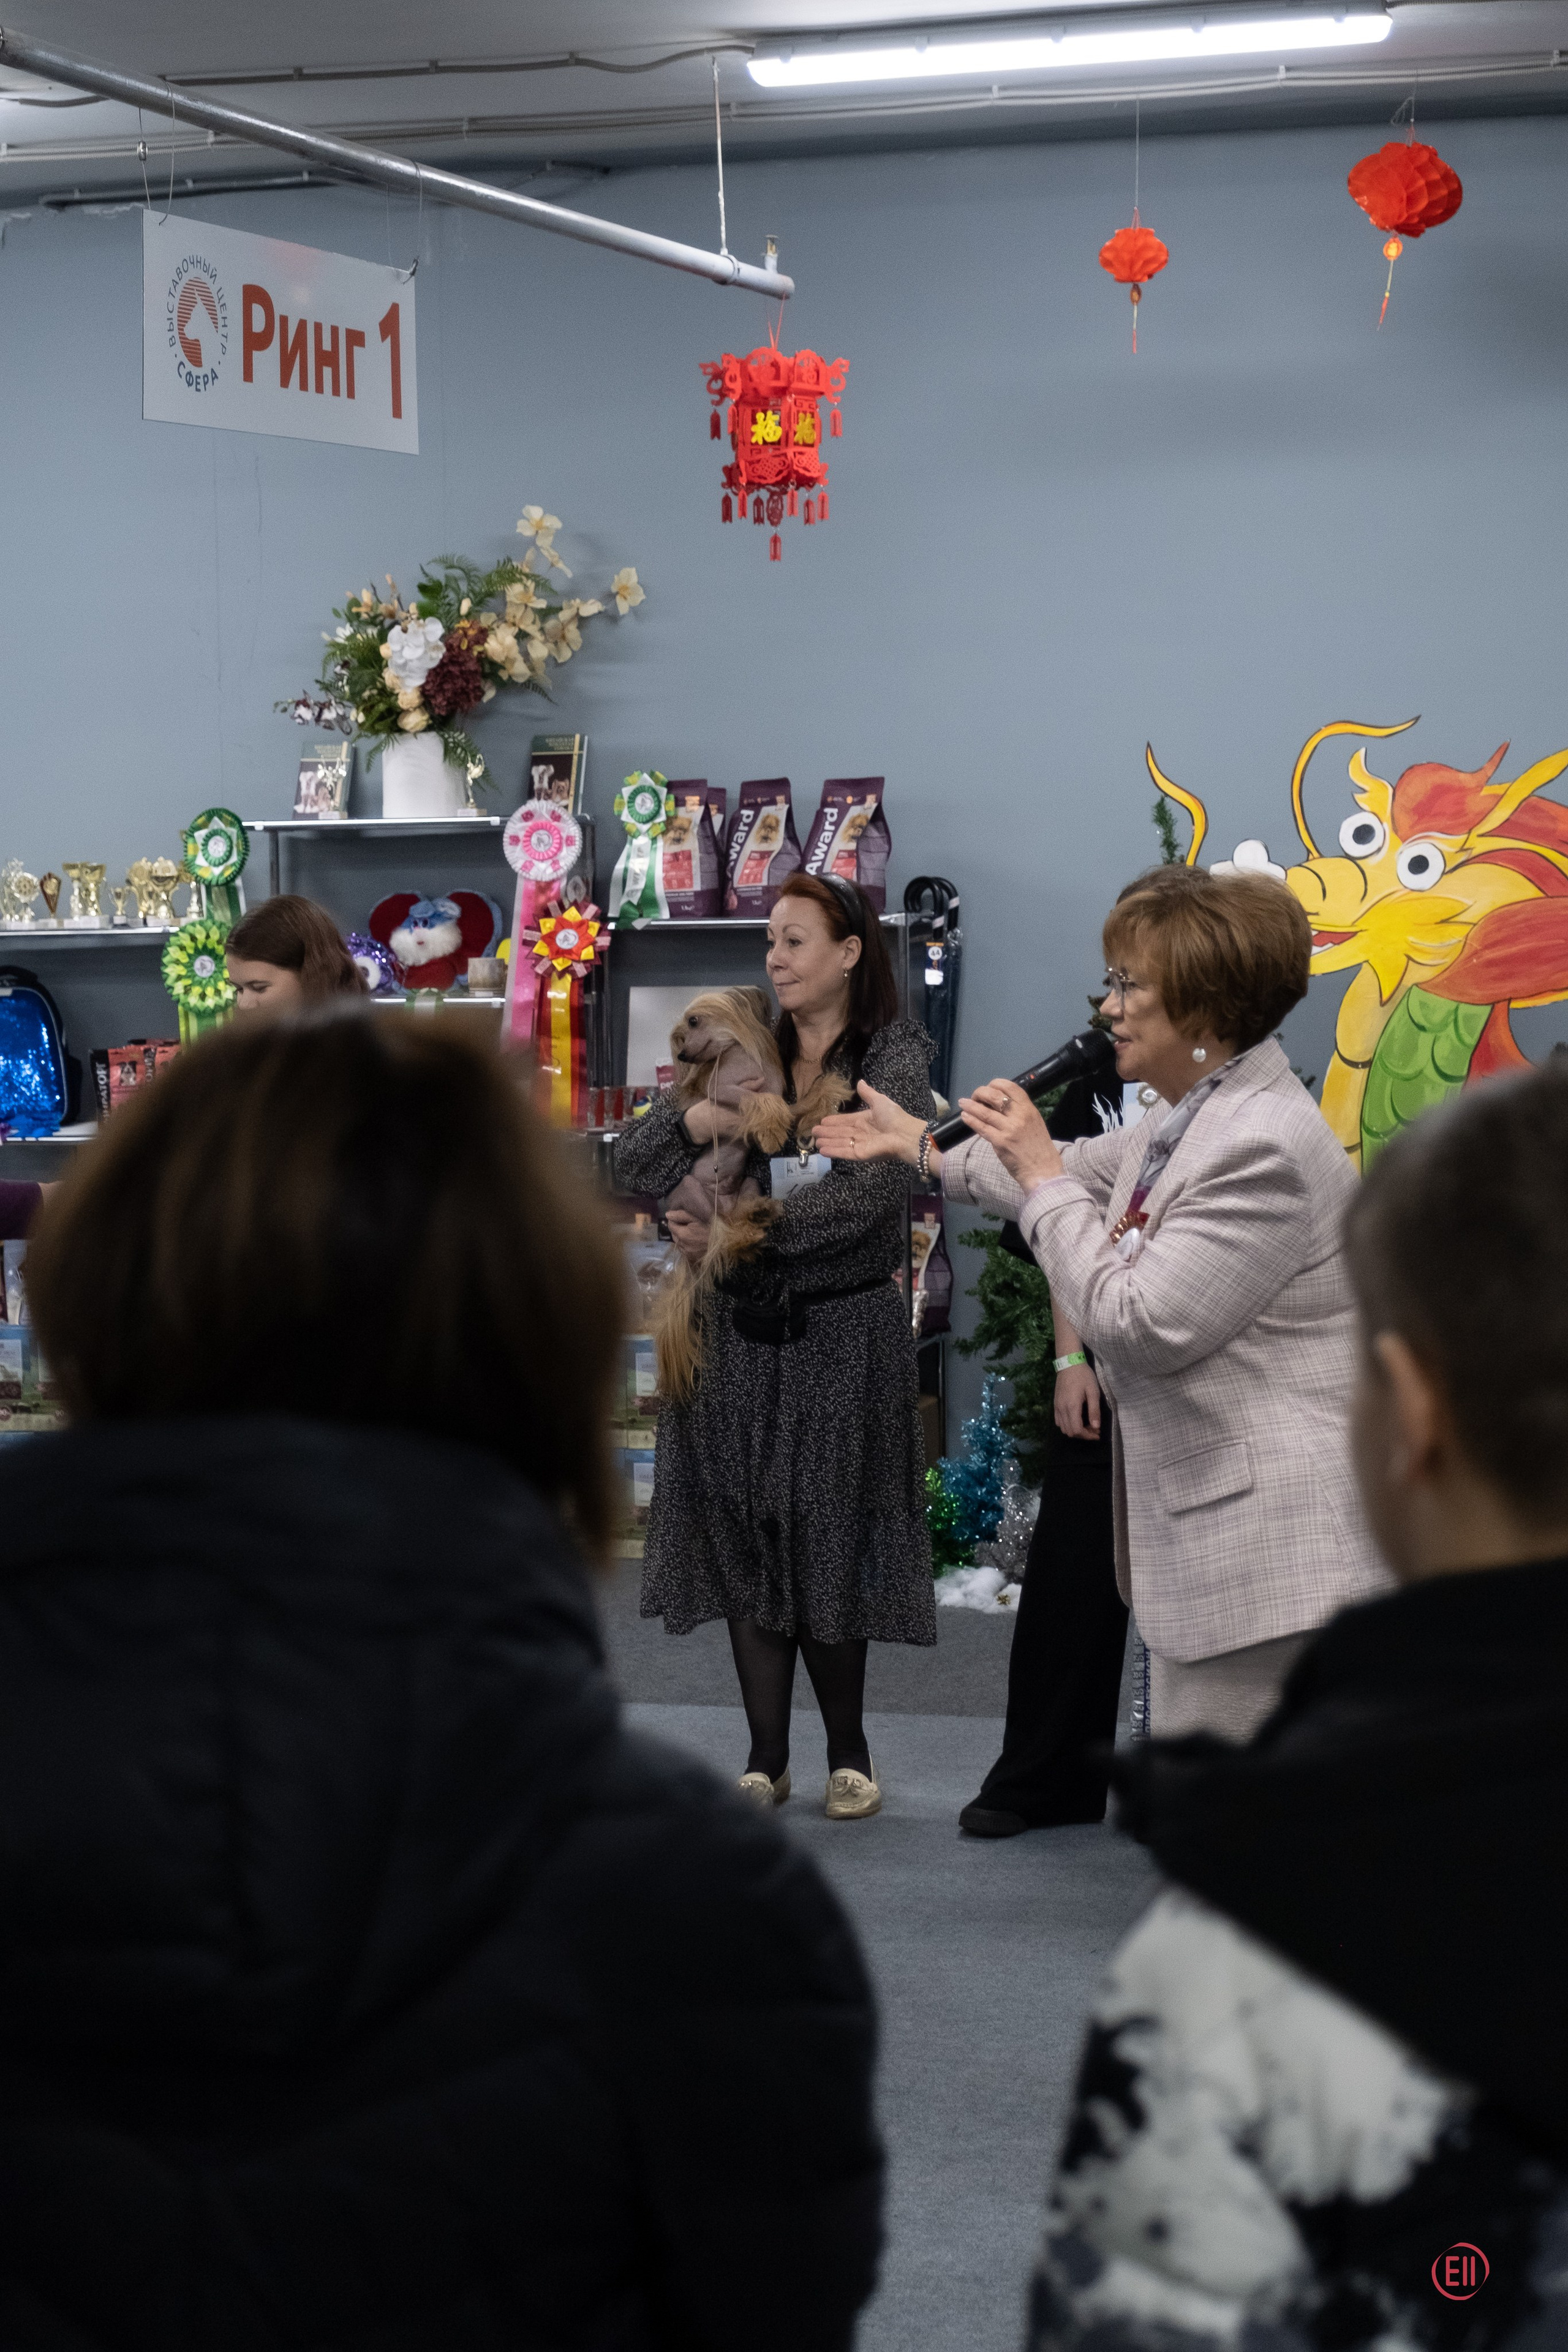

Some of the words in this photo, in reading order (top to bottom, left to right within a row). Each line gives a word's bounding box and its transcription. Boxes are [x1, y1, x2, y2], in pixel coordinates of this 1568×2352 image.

[167, 255, 219, 348] ВЫСТАВОЧНЫЙ
[216, 286, 228, 356] ЦЕНТР
[177, 360, 219, 393] СФЕРА
[243, 284, 366, 400] Ринг
[379, 302, 402, 419] 1
[805, 807, 839, 875] Award
[96, 1062, 109, 1118] ИРАТОРГ
